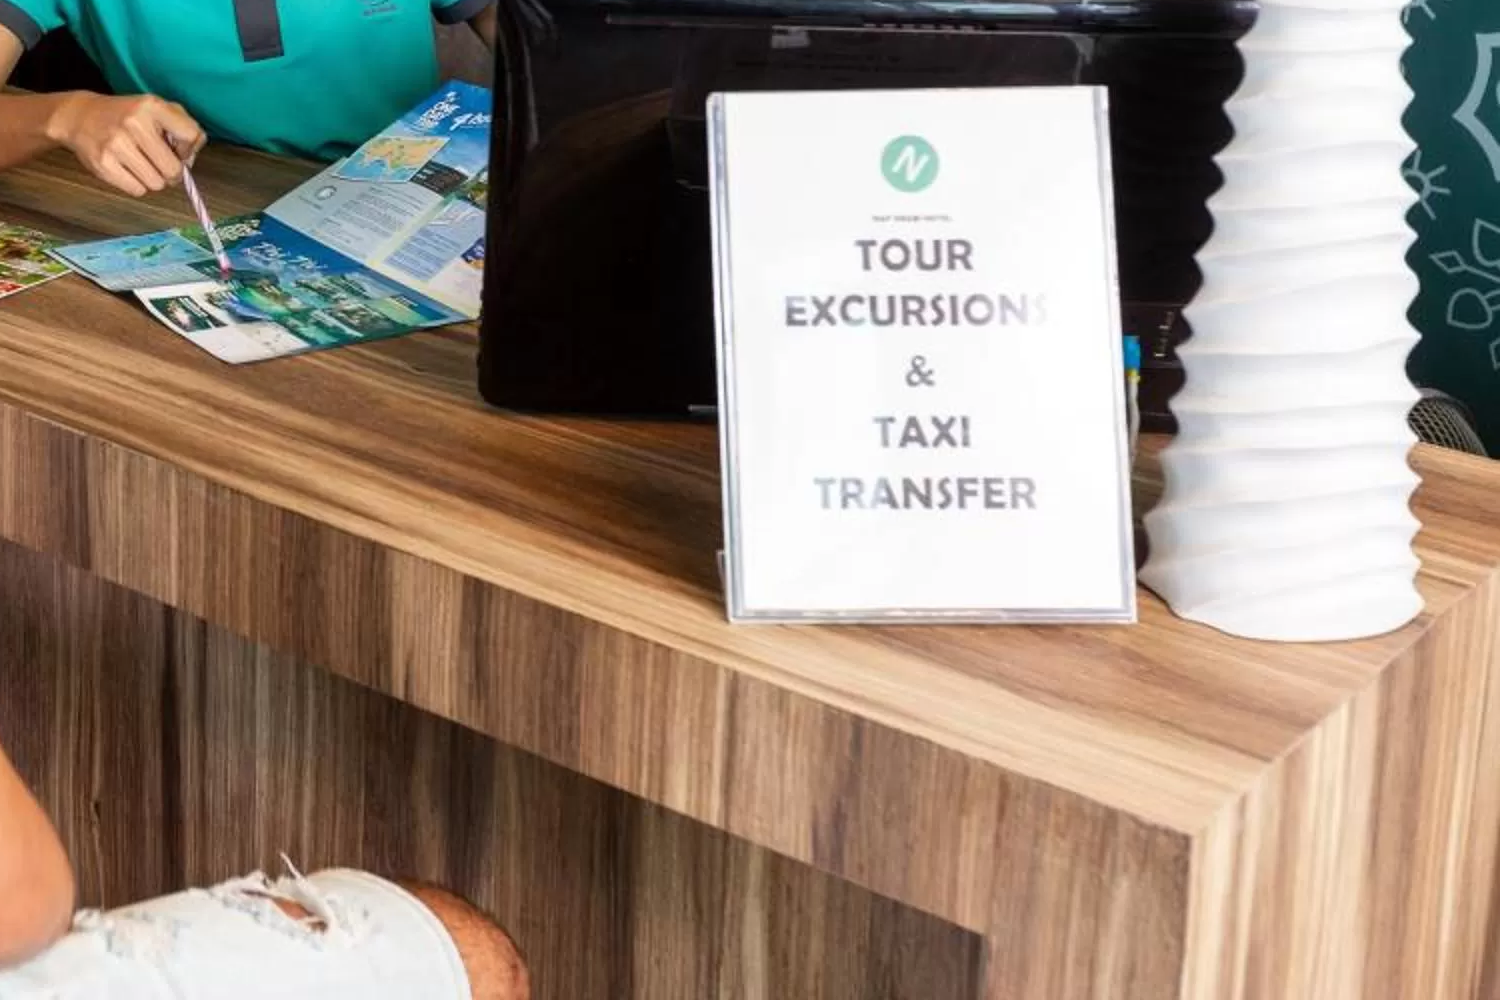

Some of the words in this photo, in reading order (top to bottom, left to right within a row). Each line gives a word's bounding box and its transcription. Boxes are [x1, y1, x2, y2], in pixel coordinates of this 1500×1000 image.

[854, 238, 974, 272] TOUR
[784, 293, 1047, 328] EXCURSIONS
[904, 354, 936, 388] &
[872, 414, 971, 450] TAXI
[813, 476, 1037, 511] TRANSFER
